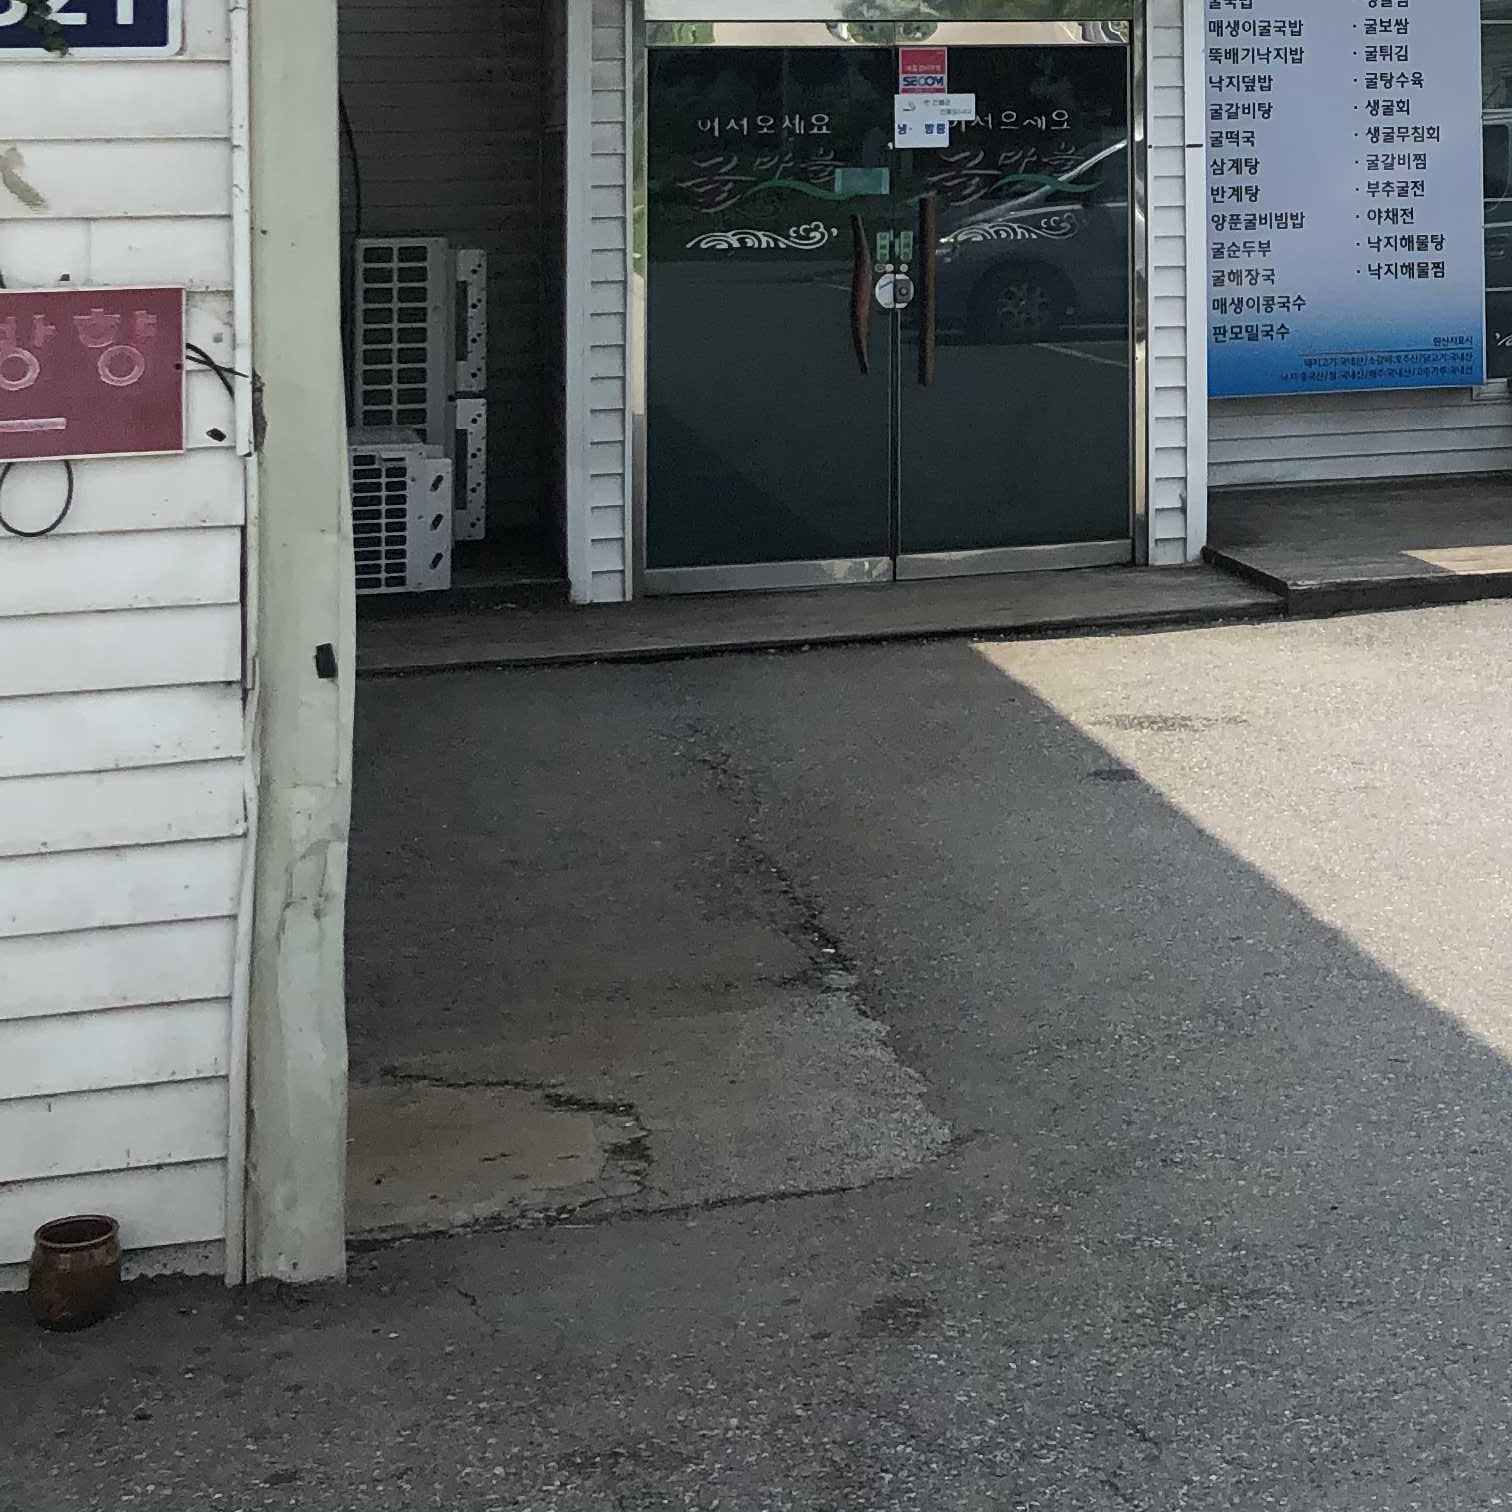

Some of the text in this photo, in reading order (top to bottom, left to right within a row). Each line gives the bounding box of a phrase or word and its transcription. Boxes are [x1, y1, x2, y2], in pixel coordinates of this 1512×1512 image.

[1208, 19, 1304, 38] 매생이굴국밥
[1363, 17, 1410, 35] 굴보쌈
[1208, 46, 1305, 65] 뚝배기낙지밥
[1364, 44, 1409, 63] 굴튀김
[1208, 74, 1274, 93] 낙지덮밥
[1364, 71, 1425, 90] 굴탕수육
[1209, 101, 1274, 121] 굴갈비탕
[1364, 98, 1410, 117] 생굴회
[1209, 129, 1256, 148] 굴떡국
[1365, 125, 1440, 144] 생굴무침회
[1209, 157, 1260, 176] 삼계탕
[1365, 152, 1427, 171] 굴갈비찜
[1210, 184, 1261, 204] 반계탕
[1366, 179, 1425, 198] 부추굴전
[1210, 211, 1306, 232] 양푼굴비빔밥
[1366, 207, 1415, 226] 야채전
[1211, 239, 1272, 260] 굴순두부
[1367, 233, 1446, 253] 낙지해물탕
[1211, 268, 1276, 288] 굴해장국
[1367, 260, 1445, 281] 낙지해물찜
[1211, 294, 1307, 315] 매생이콩국수
[1212, 322, 1290, 344] 판모밀국수
